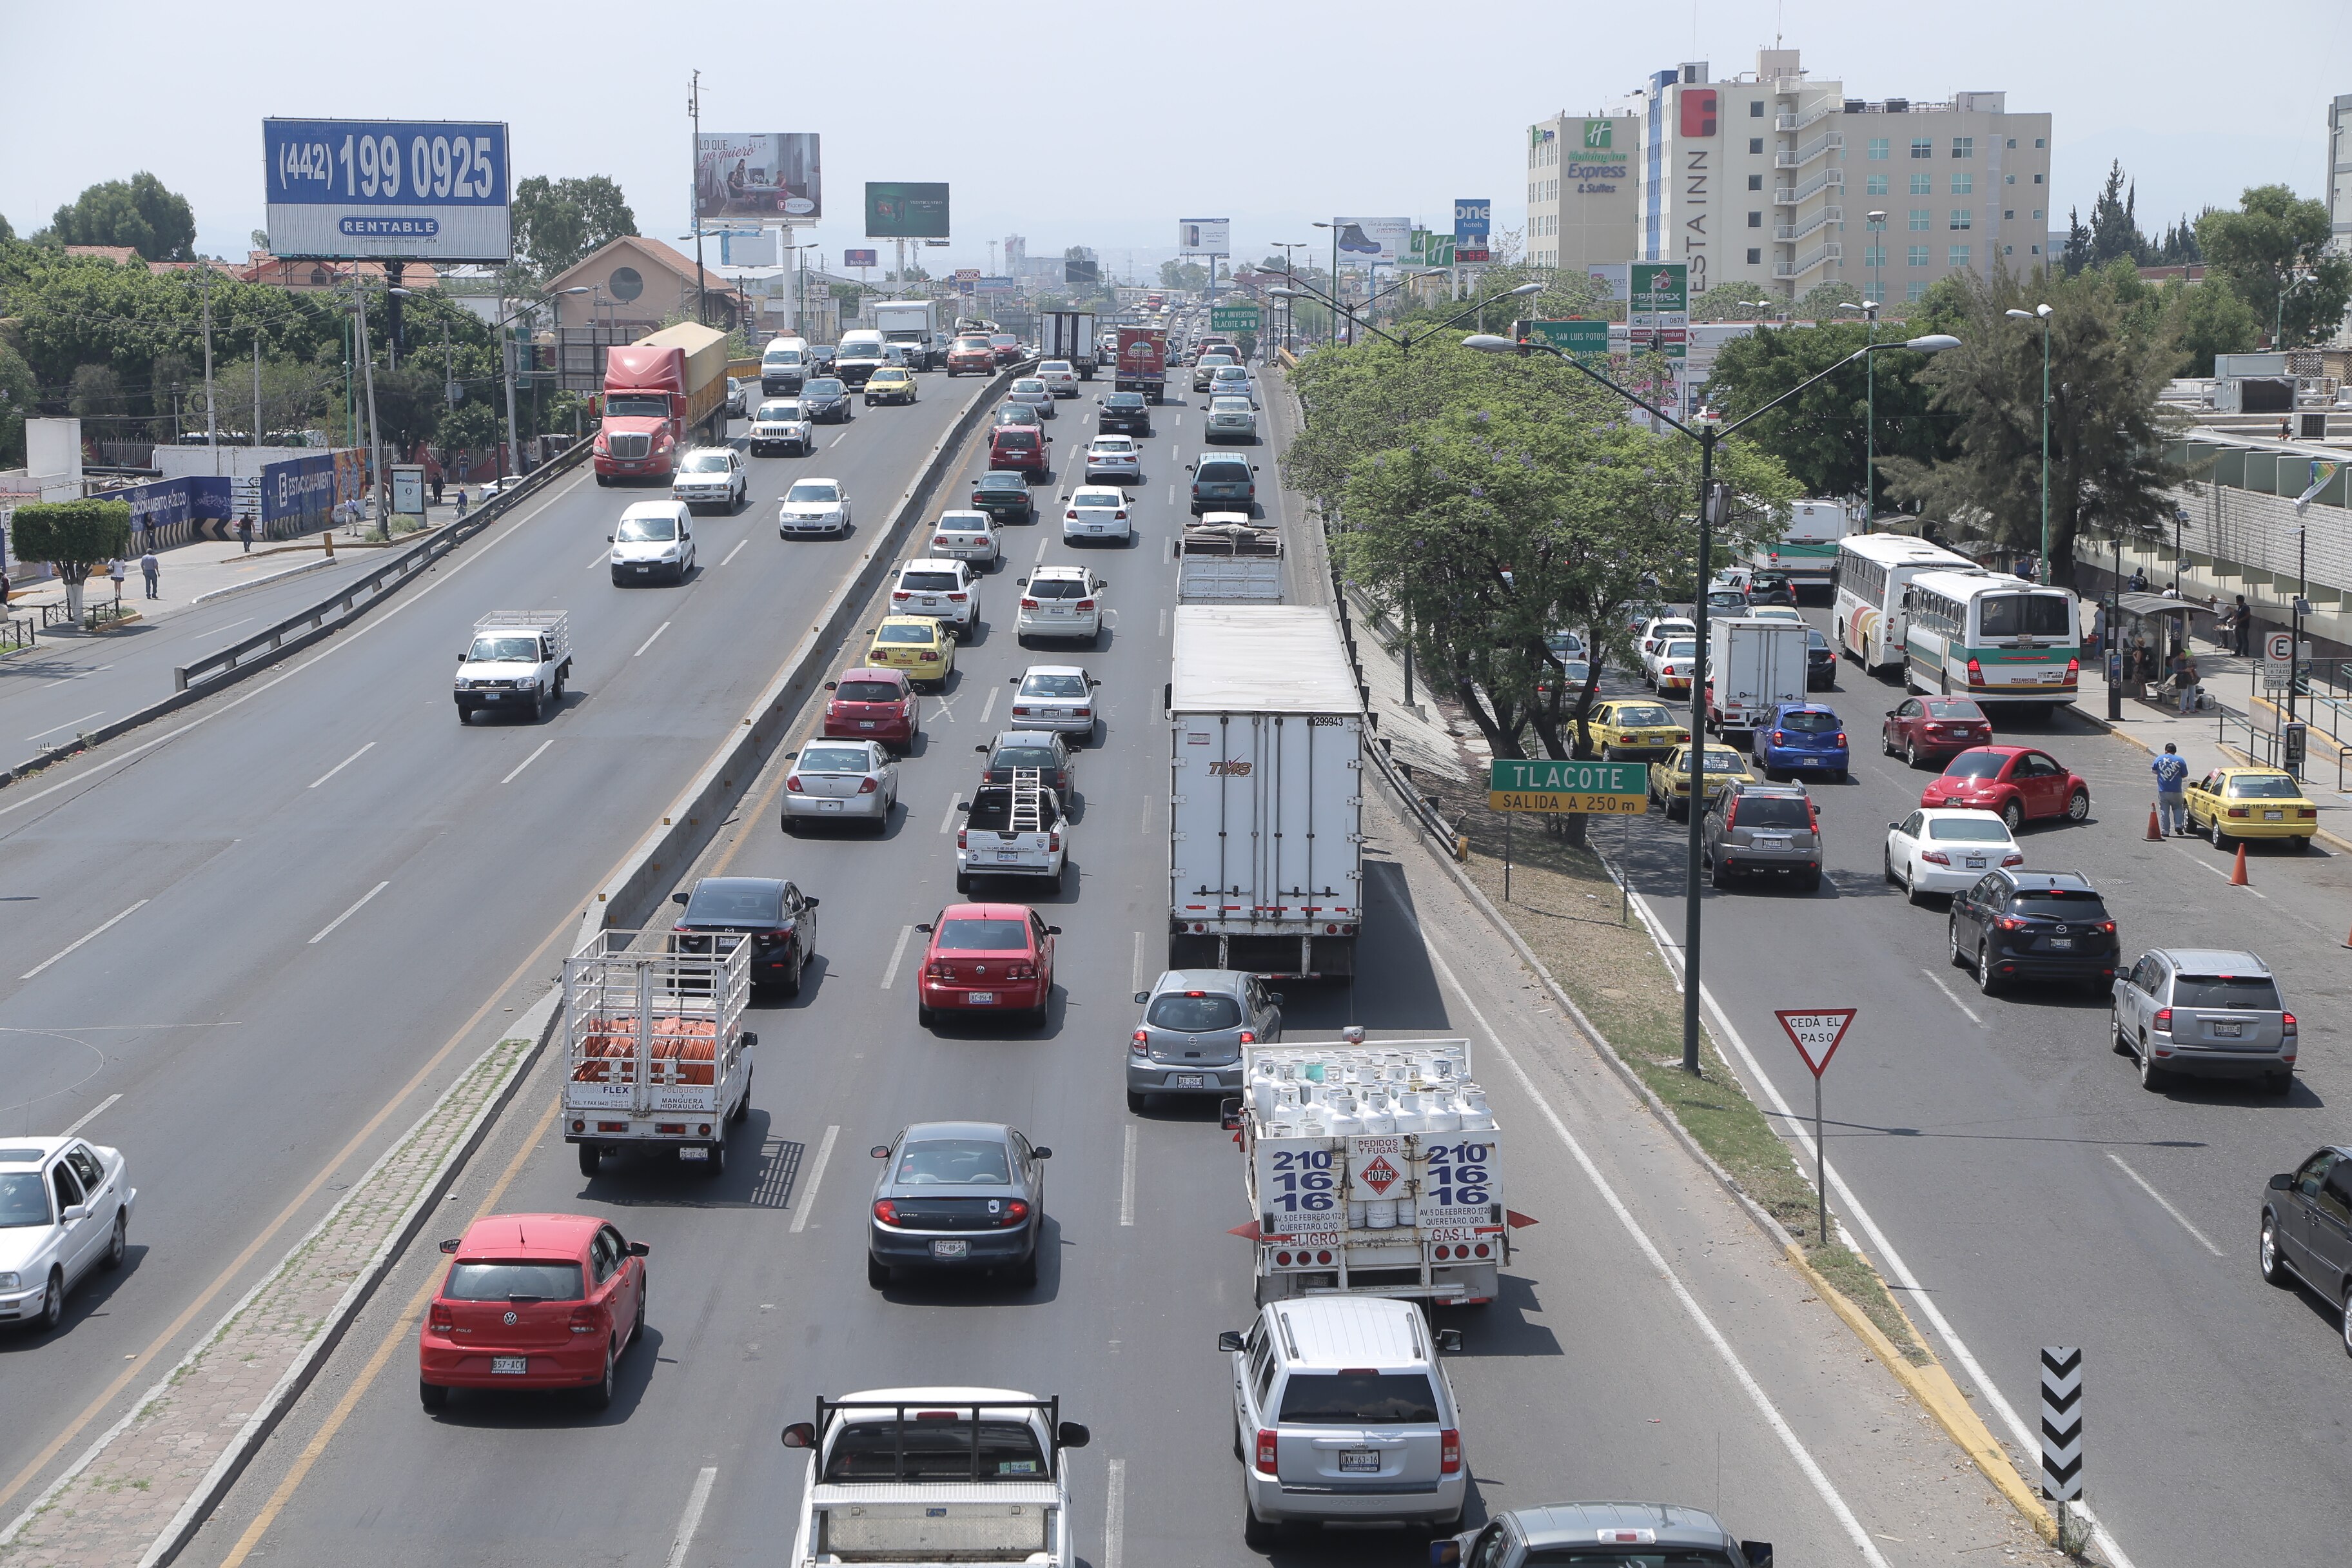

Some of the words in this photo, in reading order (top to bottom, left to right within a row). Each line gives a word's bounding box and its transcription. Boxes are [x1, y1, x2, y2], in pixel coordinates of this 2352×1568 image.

[712, 140, 727, 150] QUE
[718, 146, 754, 164] quiero
[1568, 152, 1610, 163] Holiday
[1611, 150, 1627, 161] Inn
[279, 142, 333, 190] (442)
[340, 135, 400, 197] 199
[411, 135, 493, 198] 0925
[1567, 163, 1626, 181] Express
[1586, 183, 1616, 193] Suites
[1455, 206, 1490, 220] one
[344, 221, 435, 232] RENTABLE
[1571, 332, 1583, 340] LUIS
[2275, 640, 2288, 656] E
[1315, 716, 1343, 727] 299943
[1210, 761, 1252, 775] TMS
[1513, 766, 1623, 789] TLACOTE
[1504, 794, 1559, 809] SALIDA
[1568, 797, 1578, 810] A
[1587, 796, 1616, 810] 250
[1622, 801, 1635, 811] m
[1790, 1017, 1821, 1028] CEDA
[1827, 1017, 1841, 1026] EL
[1801, 1033, 1834, 1043] PASO
[573, 1086, 629, 1094] TUBOFLEX
[1358, 1139, 1398, 1148] PEDIDOS
[1428, 1144, 1487, 1164] 210
[1273, 1151, 1333, 1171] 210
[1273, 1171, 1333, 1191] 16
[1368, 1170, 1391, 1181] 1075
[1428, 1165, 1488, 1185] 16
[1273, 1192, 1333, 1211] 16
[1429, 1186, 1489, 1206] 16
[1280, 1223, 1322, 1231] QUERETARO,
[1290, 1233, 1338, 1246] ELIGRO
[1432, 1228, 1459, 1241] GAS
[493, 1358, 525, 1369] B57-ACV
[1341, 1455, 1378, 1465] UKM-63-16
